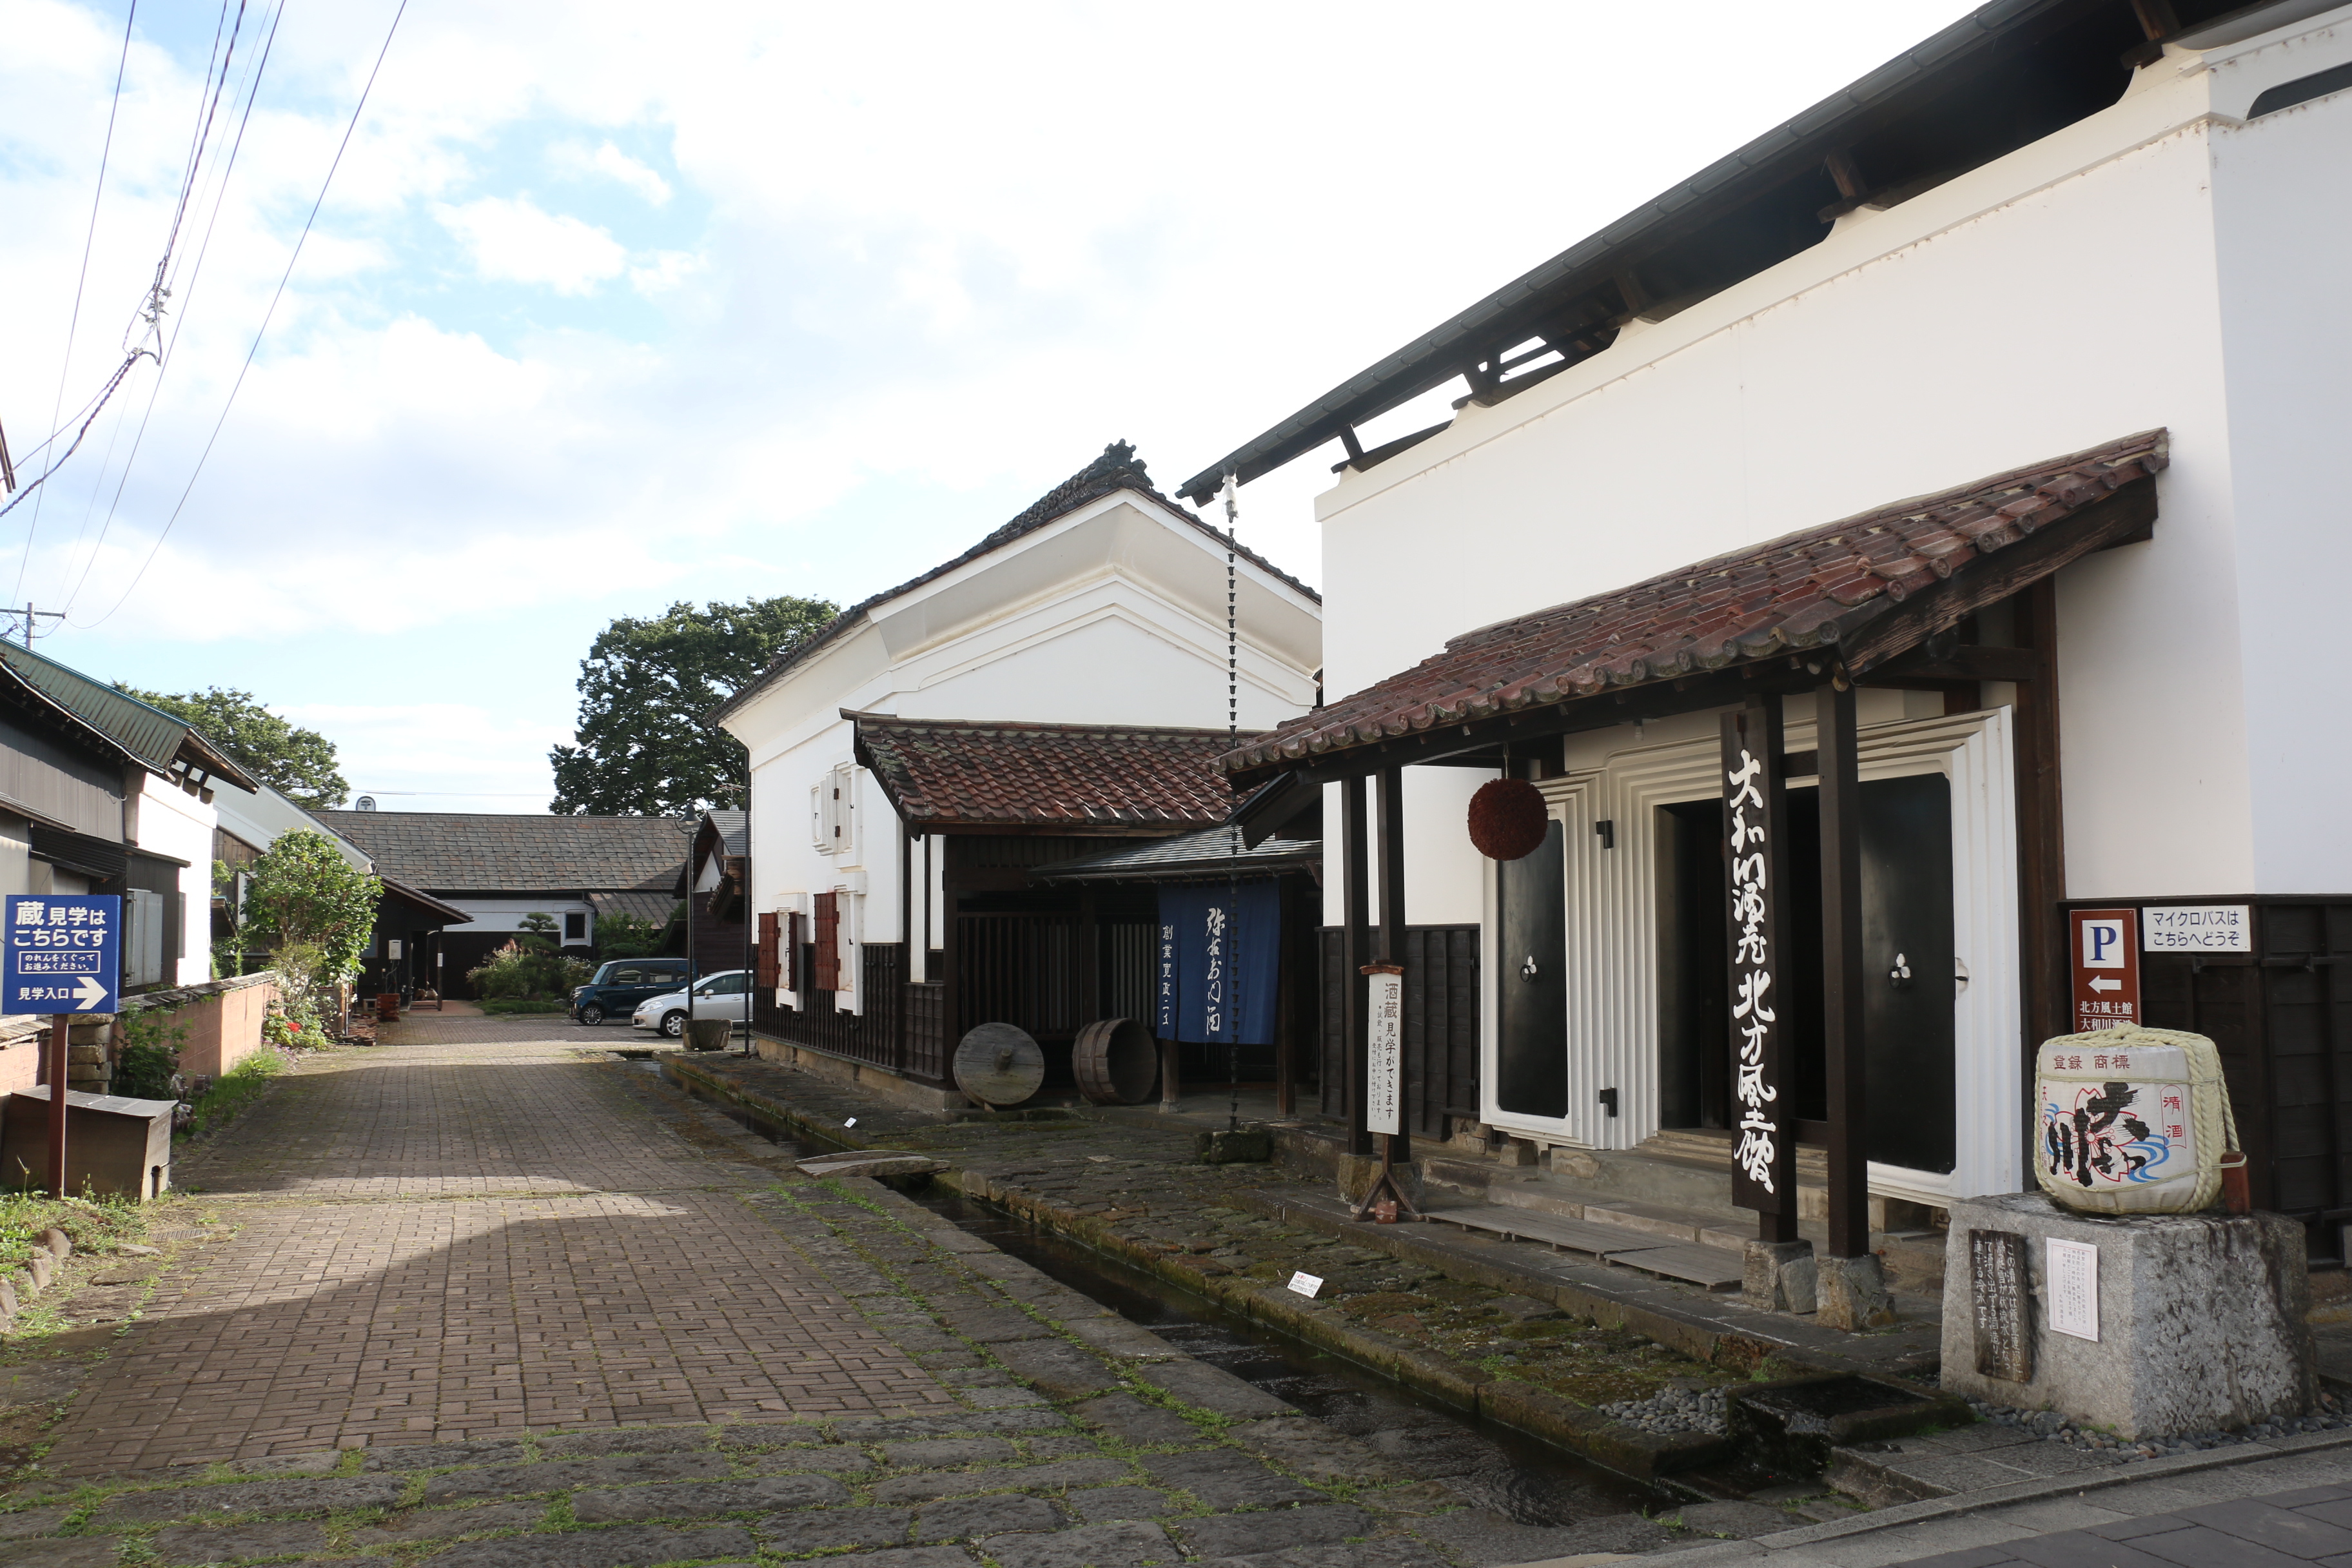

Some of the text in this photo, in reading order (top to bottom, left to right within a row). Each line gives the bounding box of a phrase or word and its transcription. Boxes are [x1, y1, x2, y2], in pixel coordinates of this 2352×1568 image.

[15, 901, 106, 926] 蔵見学は
[2152, 910, 2239, 927] マイクロバスは
[14, 928, 108, 946] こちらです
[2090, 926, 2117, 961] P
[2153, 931, 2240, 946] こちらへどうぞ
[19, 987, 69, 1000] 見学入口
[2079, 1001, 2133, 1015] 北方風土館
[1384, 983, 1398, 1120] 酒蔵見学ができます
[2162, 1095, 2182, 1139] 清酒
